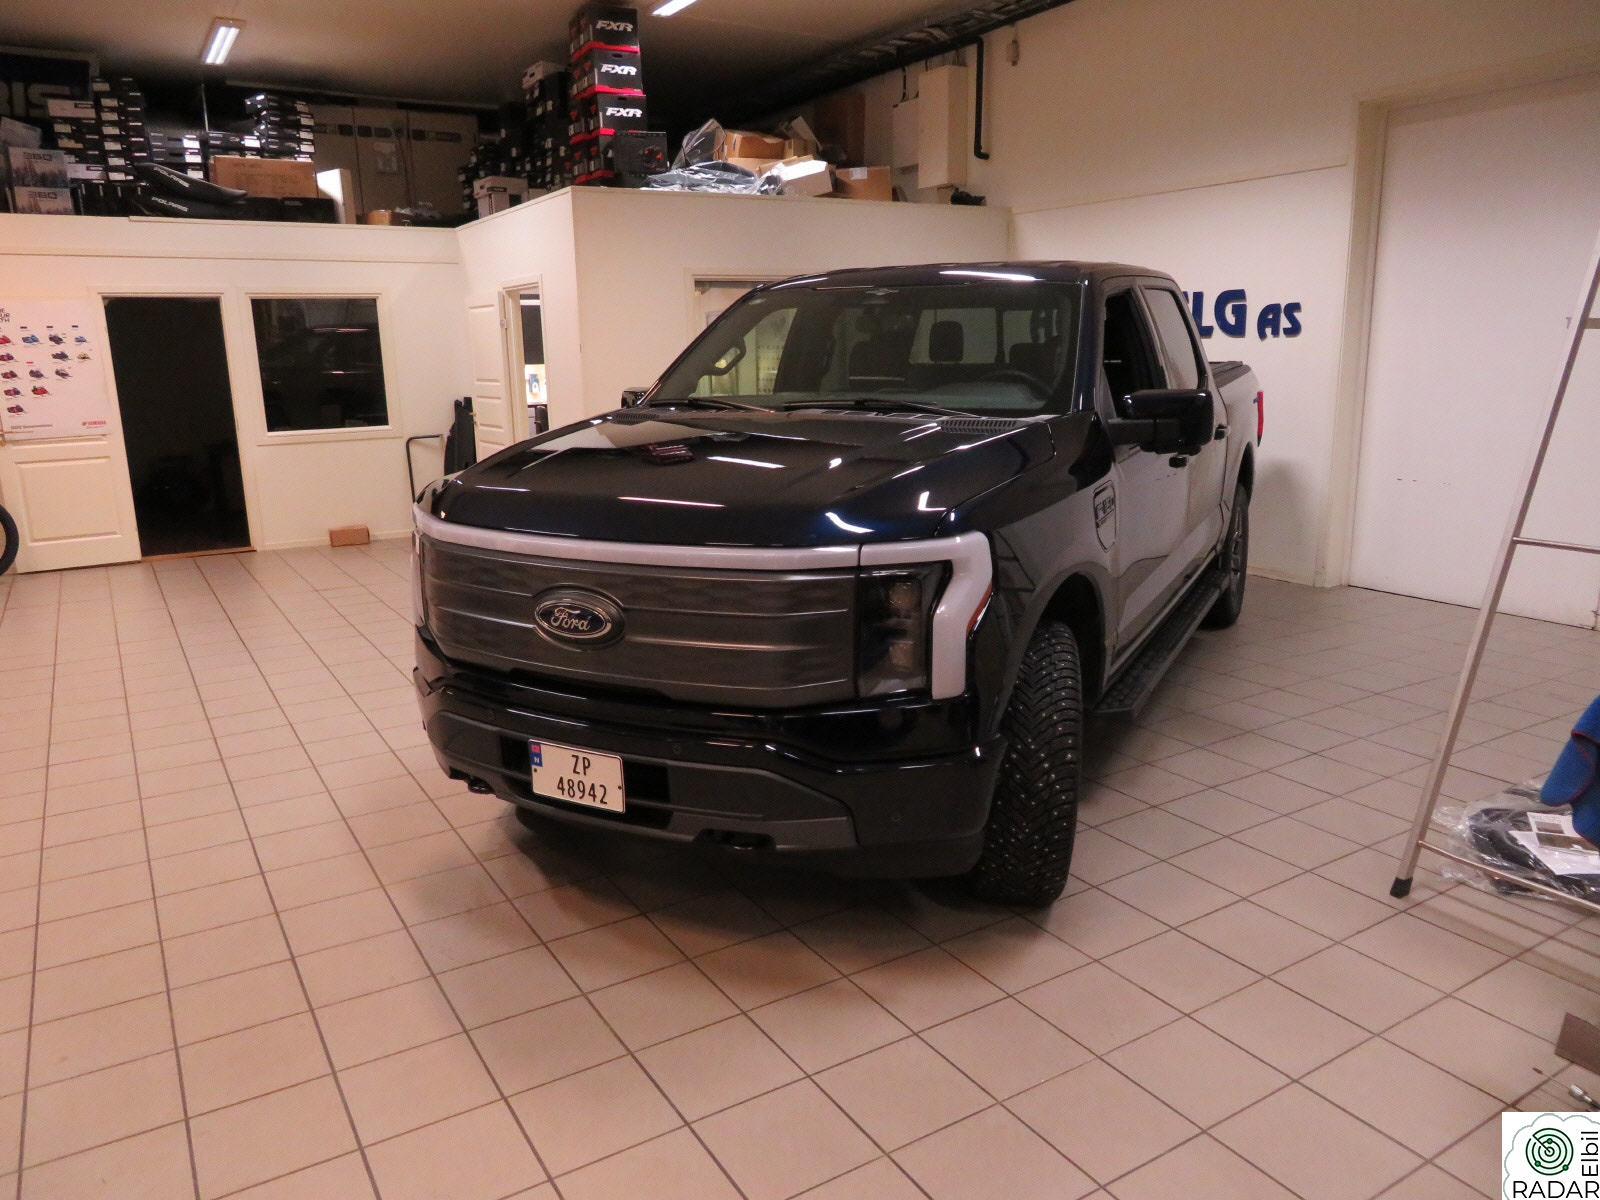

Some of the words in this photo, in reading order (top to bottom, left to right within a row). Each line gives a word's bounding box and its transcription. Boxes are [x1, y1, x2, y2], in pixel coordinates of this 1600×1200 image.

[596, 20, 634, 33] FXR
[600, 63, 638, 76] FXR
[604, 106, 643, 118] FXR
[153, 166, 190, 188] POLARIS
[151, 196, 188, 212] POLARIS
[1257, 302, 1302, 341] AS
[550, 606, 592, 631] Ford
[571, 754, 591, 776] ZP
[557, 776, 608, 805] 48942
